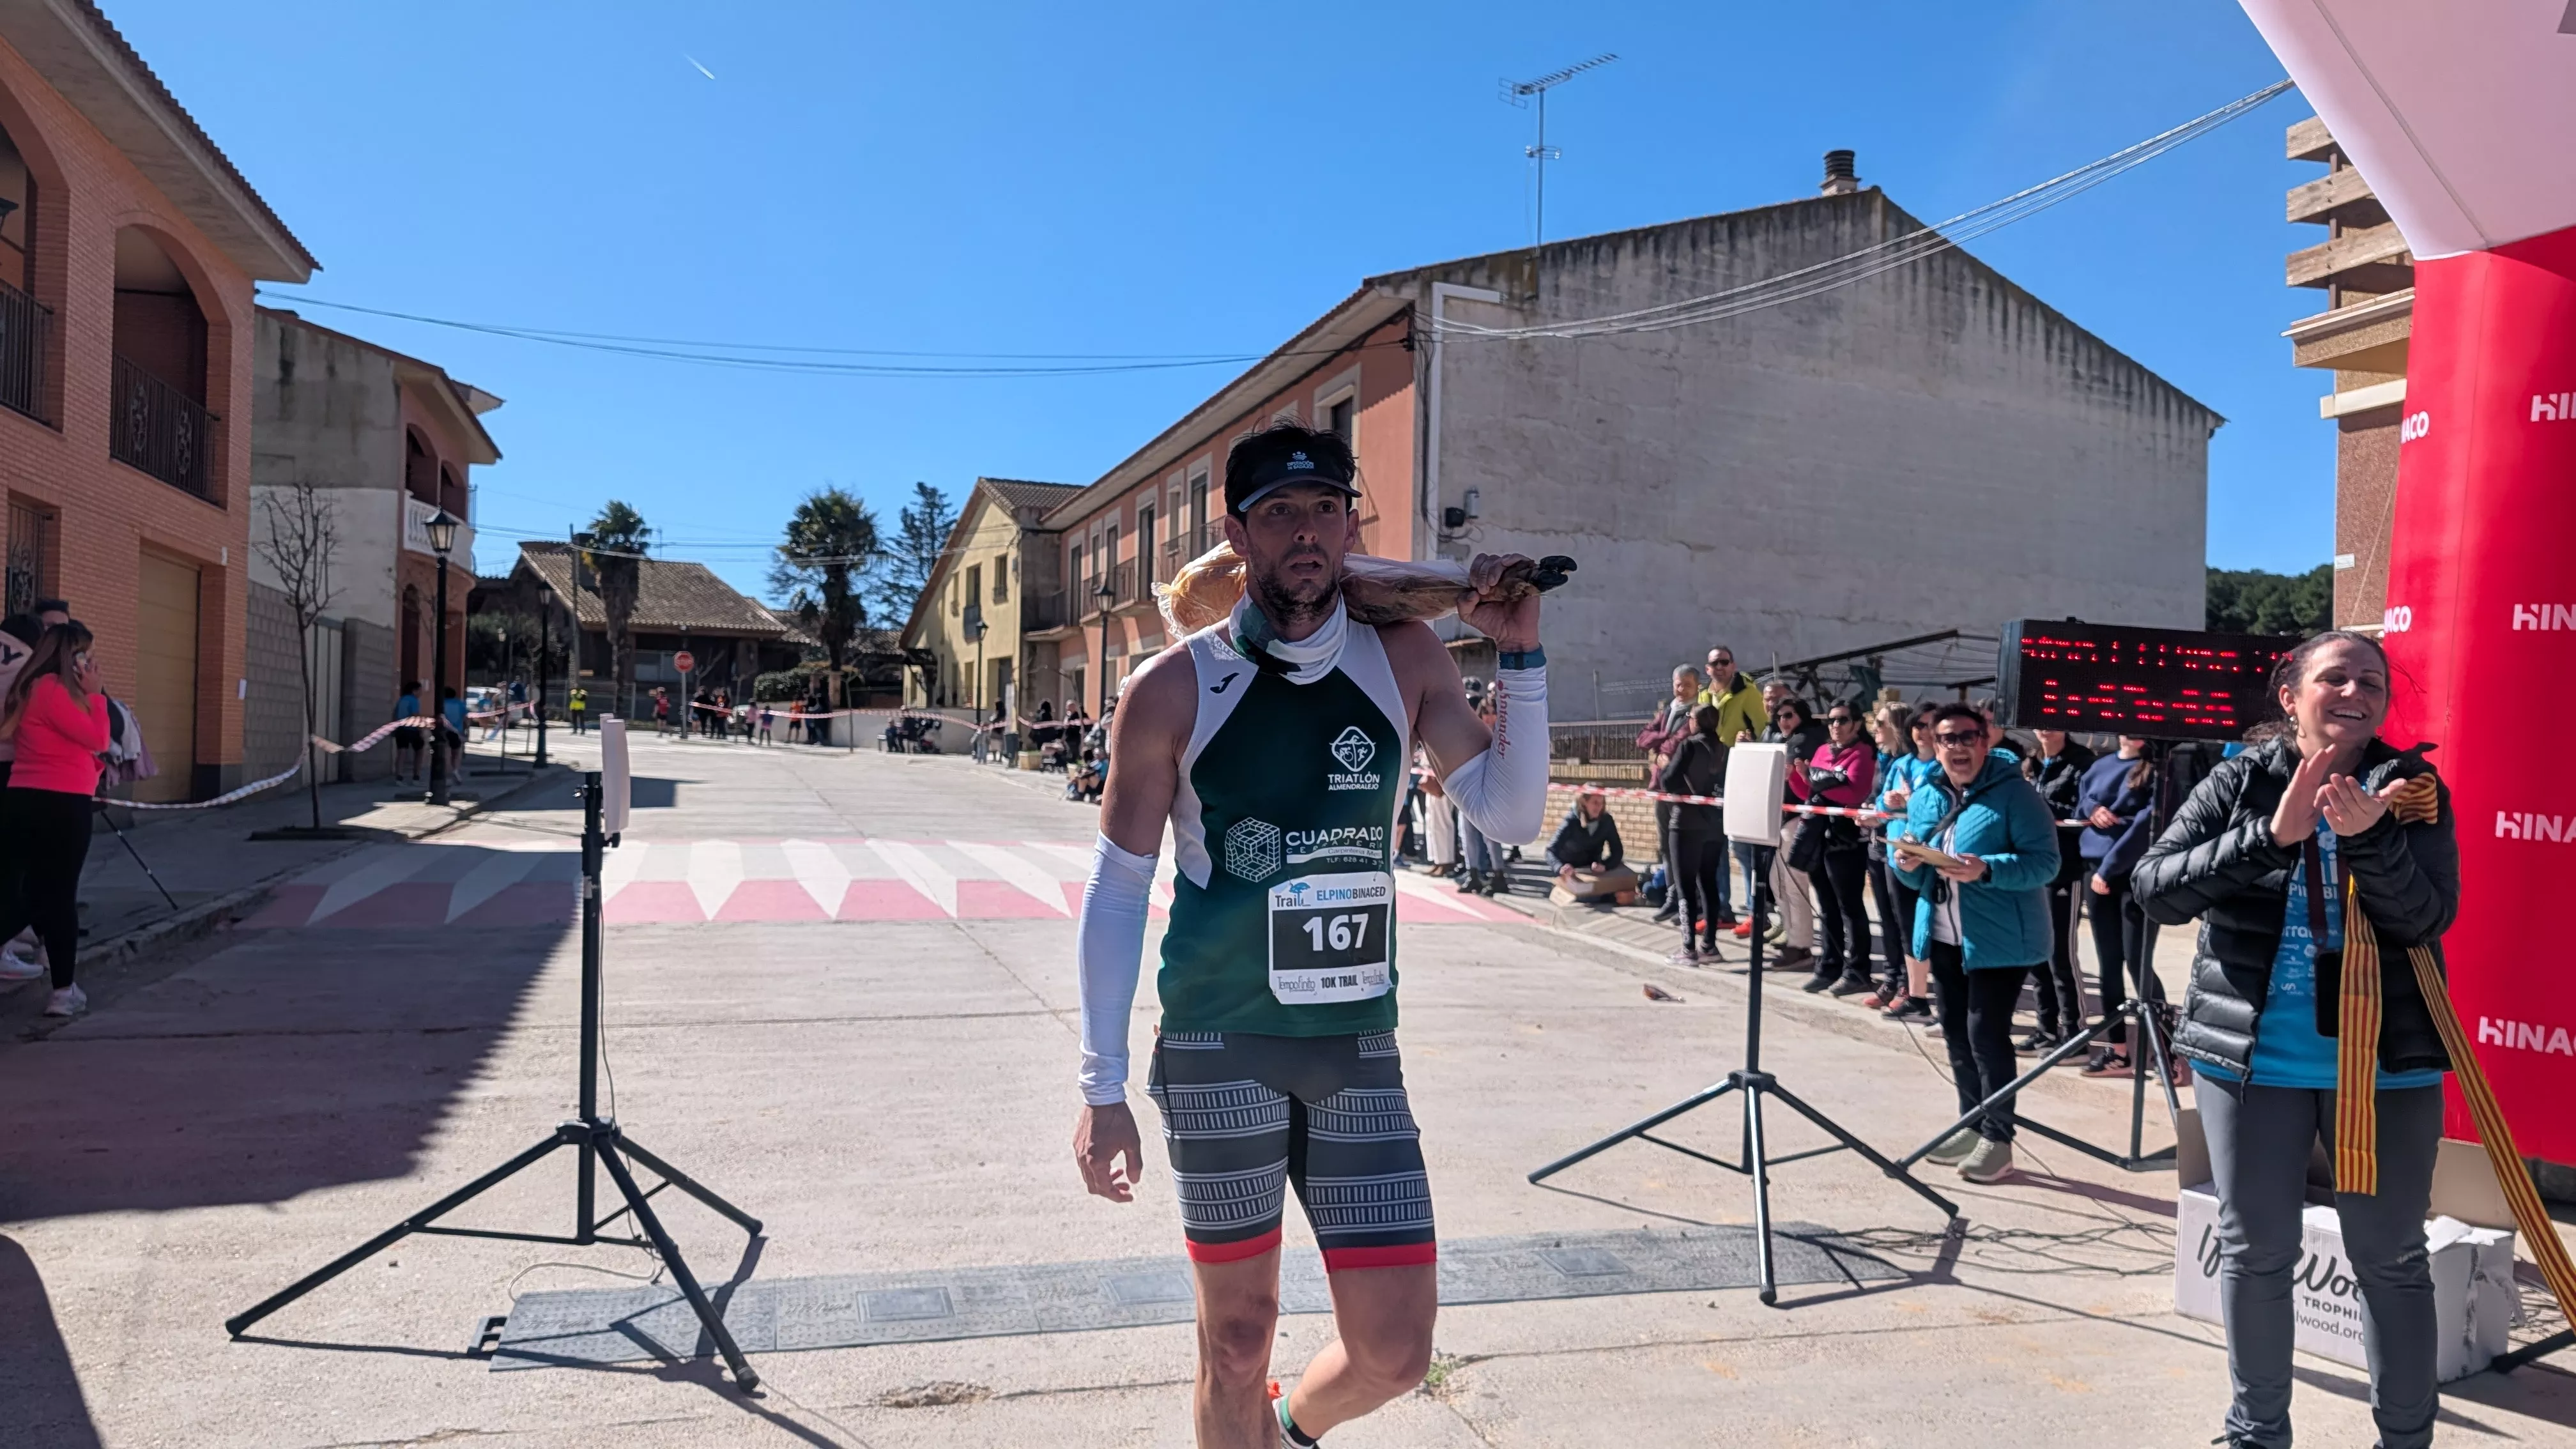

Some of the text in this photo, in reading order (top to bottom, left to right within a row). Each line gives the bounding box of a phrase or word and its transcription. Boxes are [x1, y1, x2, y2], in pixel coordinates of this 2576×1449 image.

[2531, 392, 2576, 422] HI
[1328, 770, 1380, 783] TRIATLÓN
[1285, 825, 1383, 846] CUADRADO
[1302, 913, 1369, 951] 167
[1320, 977, 1336, 988] 10K
[1338, 975, 1358, 986] TRAIL
[2478, 1015, 2576, 1057] HINA
